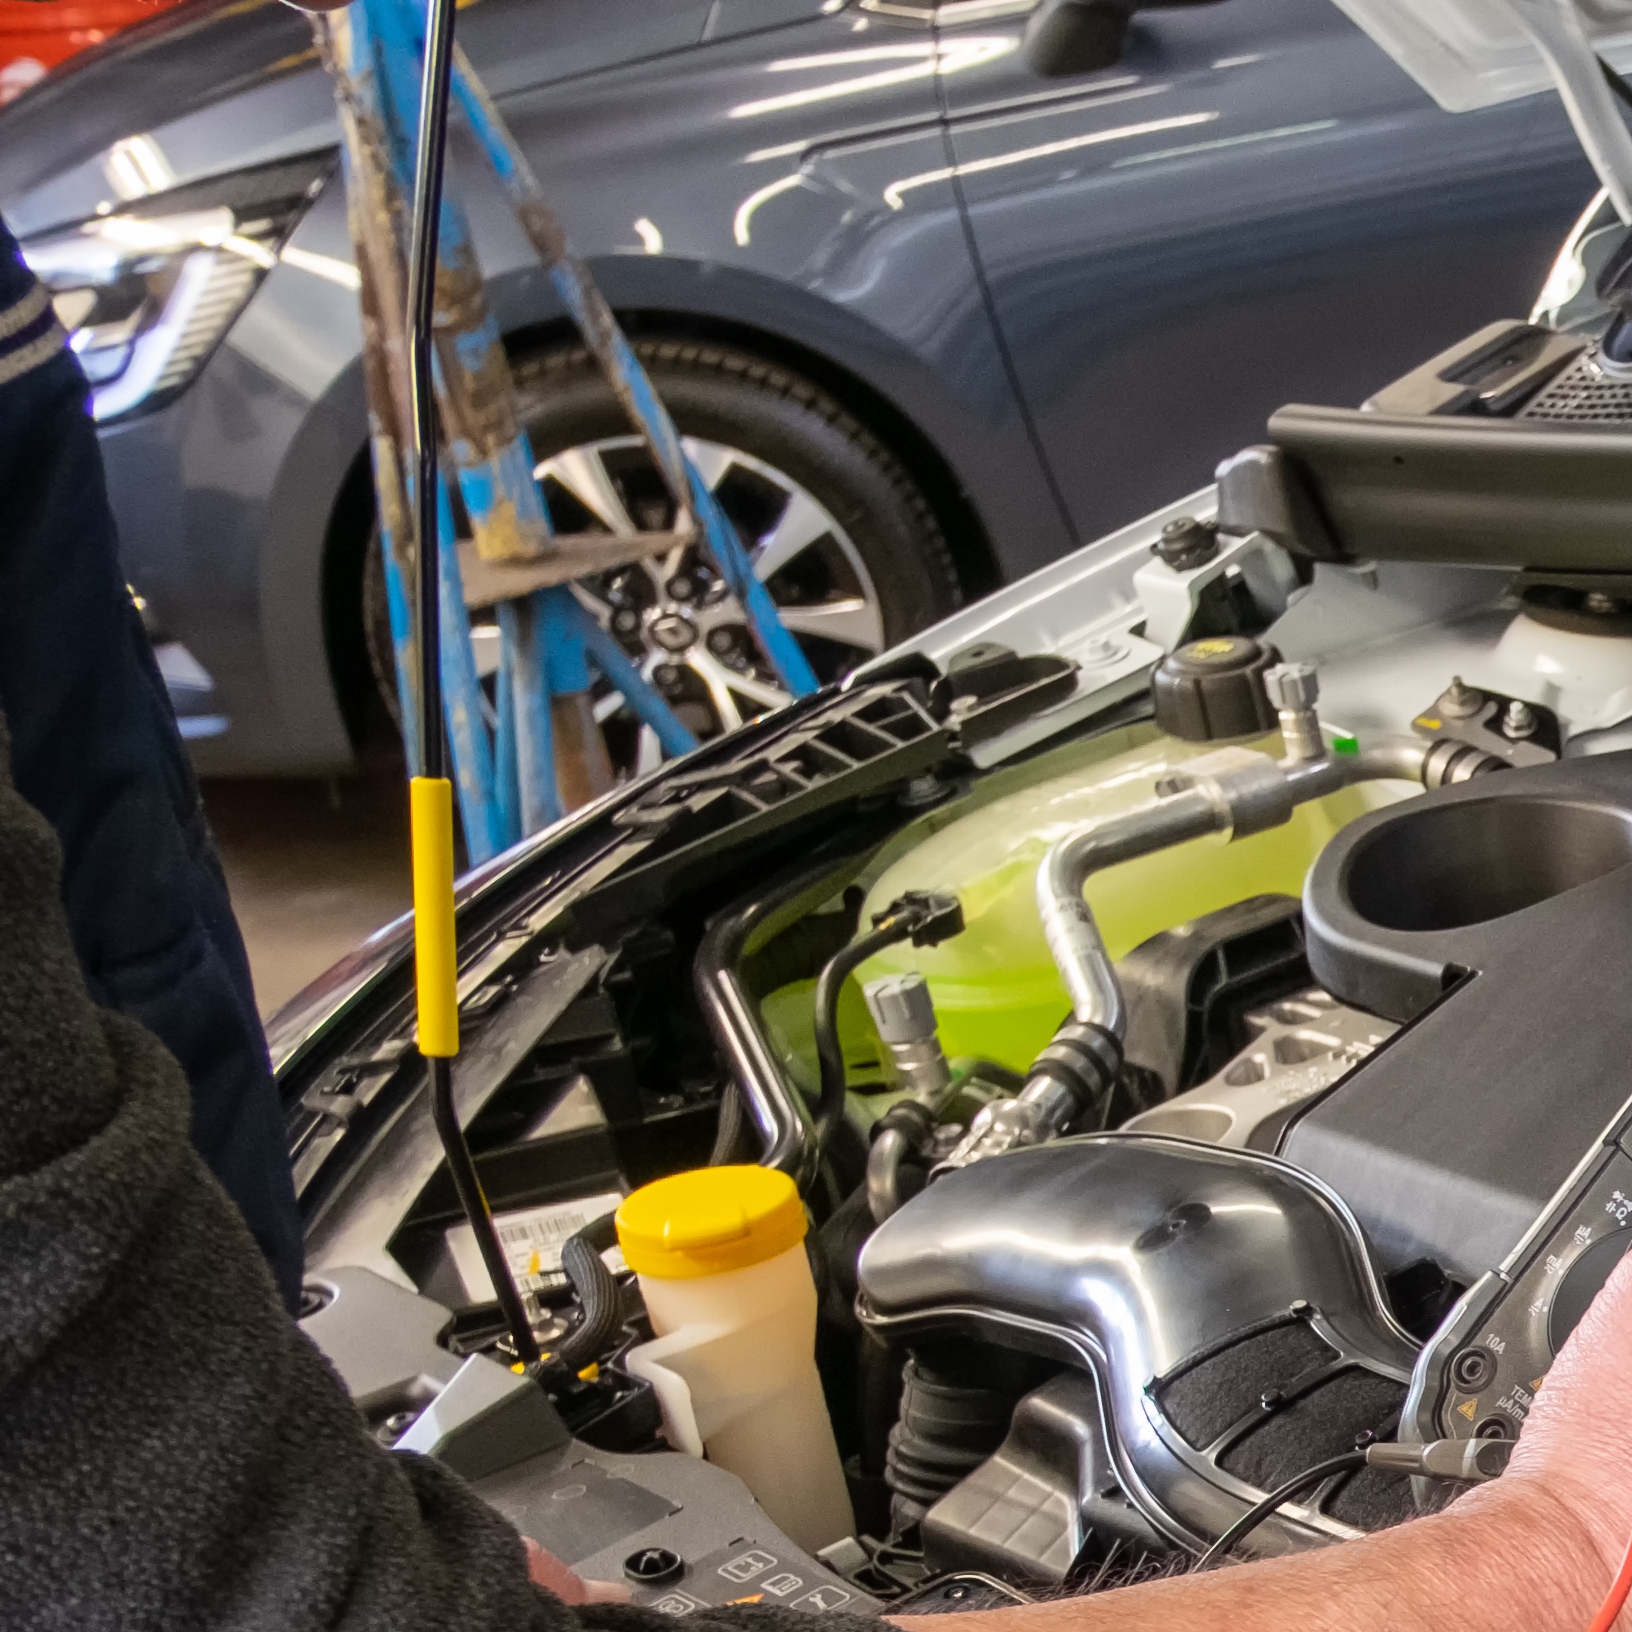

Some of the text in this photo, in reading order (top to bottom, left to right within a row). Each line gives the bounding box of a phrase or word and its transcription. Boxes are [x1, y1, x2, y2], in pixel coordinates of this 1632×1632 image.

[1485, 1334, 1506, 1355] 10A
[1511, 1385, 1534, 1406] TEM
[1496, 1396, 1525, 1421] µA/m
